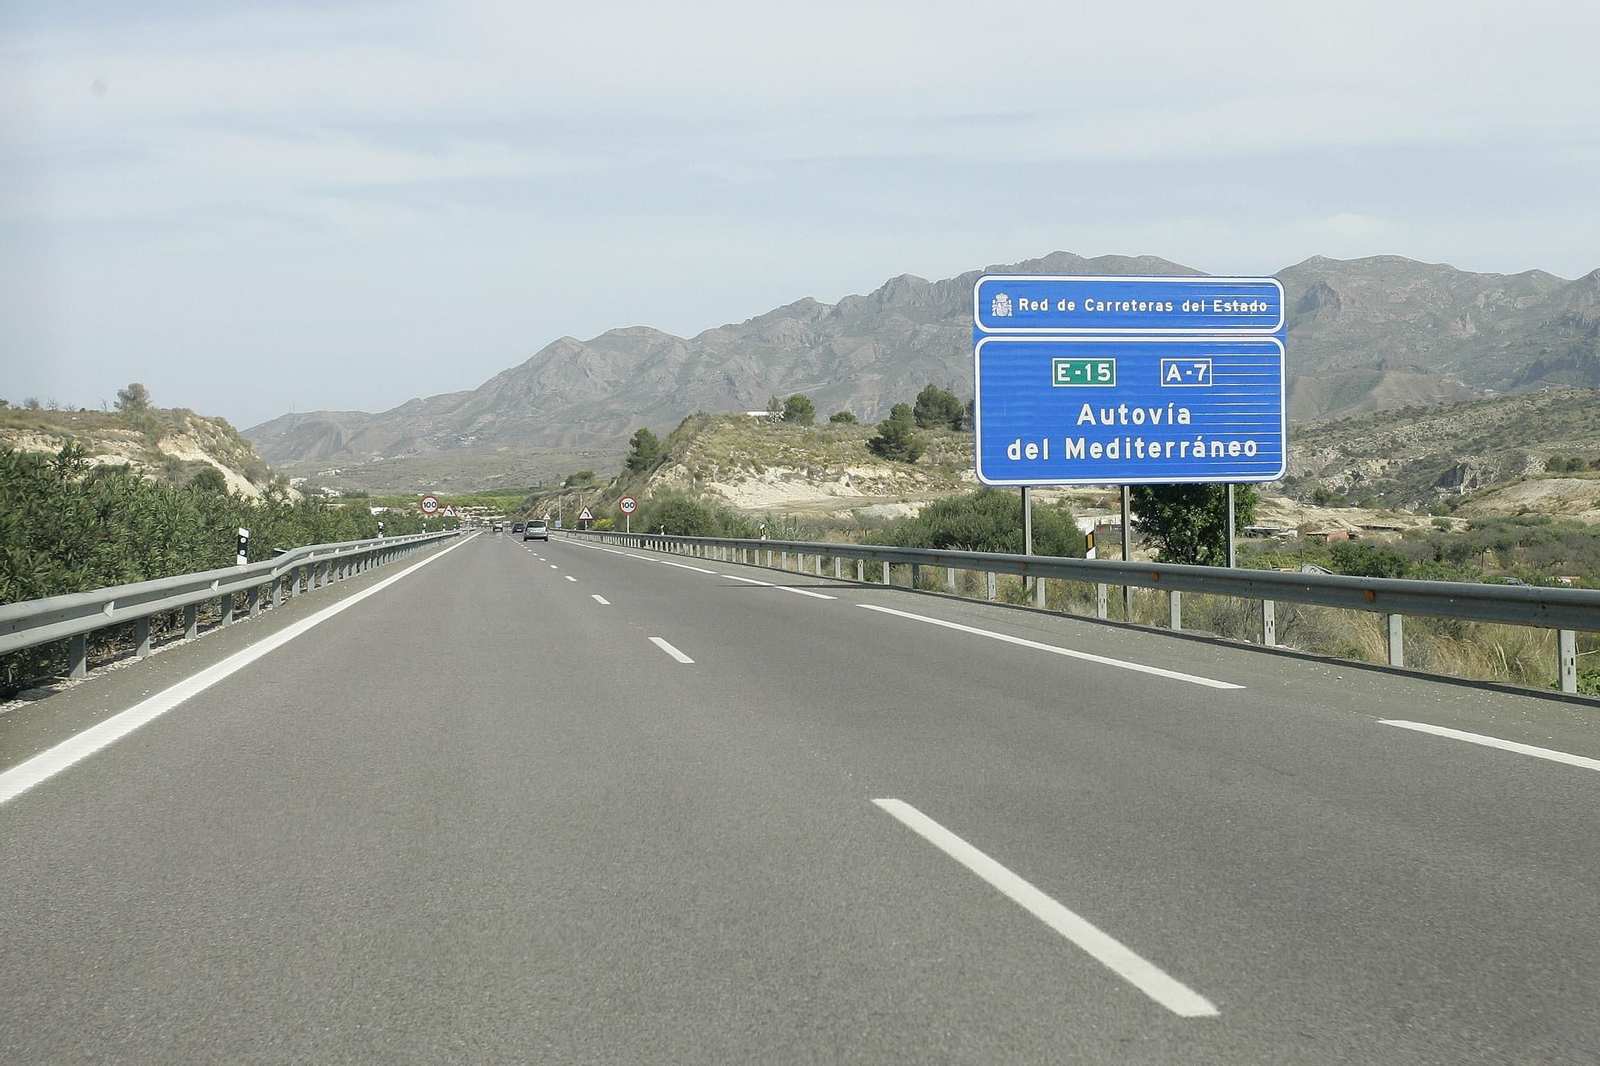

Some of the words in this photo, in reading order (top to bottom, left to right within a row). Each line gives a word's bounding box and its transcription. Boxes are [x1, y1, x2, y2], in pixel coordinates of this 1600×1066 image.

[1018, 298, 1048, 312] Red
[1057, 298, 1076, 312] de
[1084, 298, 1174, 312] Carreteras
[1181, 299, 1205, 312] del
[1213, 299, 1268, 312] Estado
[1057, 363, 1112, 382] E-15
[1166, 363, 1208, 382] A-7
[1076, 403, 1191, 426] Autovía
[1006, 438, 1049, 460] del
[1065, 437, 1257, 460] Mediterráneo
